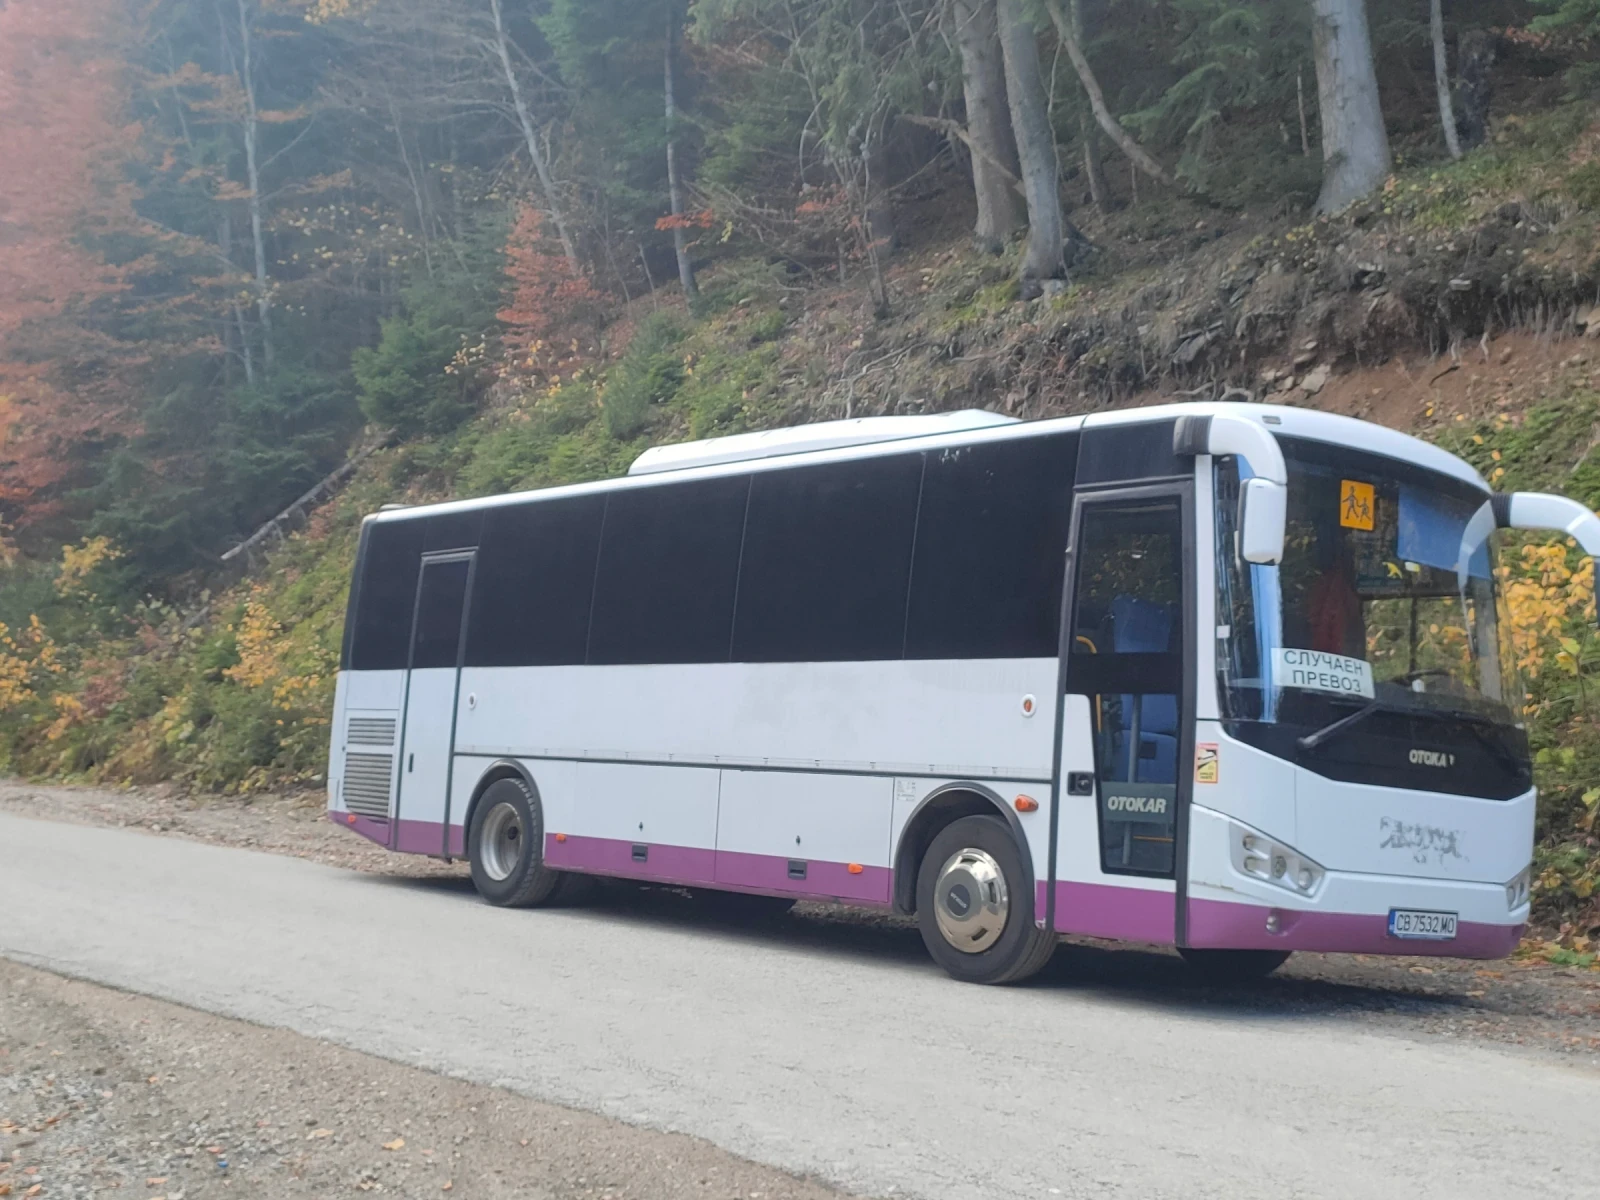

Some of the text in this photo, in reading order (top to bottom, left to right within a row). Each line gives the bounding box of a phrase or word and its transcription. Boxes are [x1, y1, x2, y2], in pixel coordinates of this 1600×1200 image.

[1284, 650, 1363, 676] СЛУЧАЕН
[1293, 670, 1361, 692] ПРЕВОЗ
[1107, 796, 1166, 813] OTOKAR
[1397, 914, 1411, 931] CB
[1412, 915, 1439, 933] 7532
